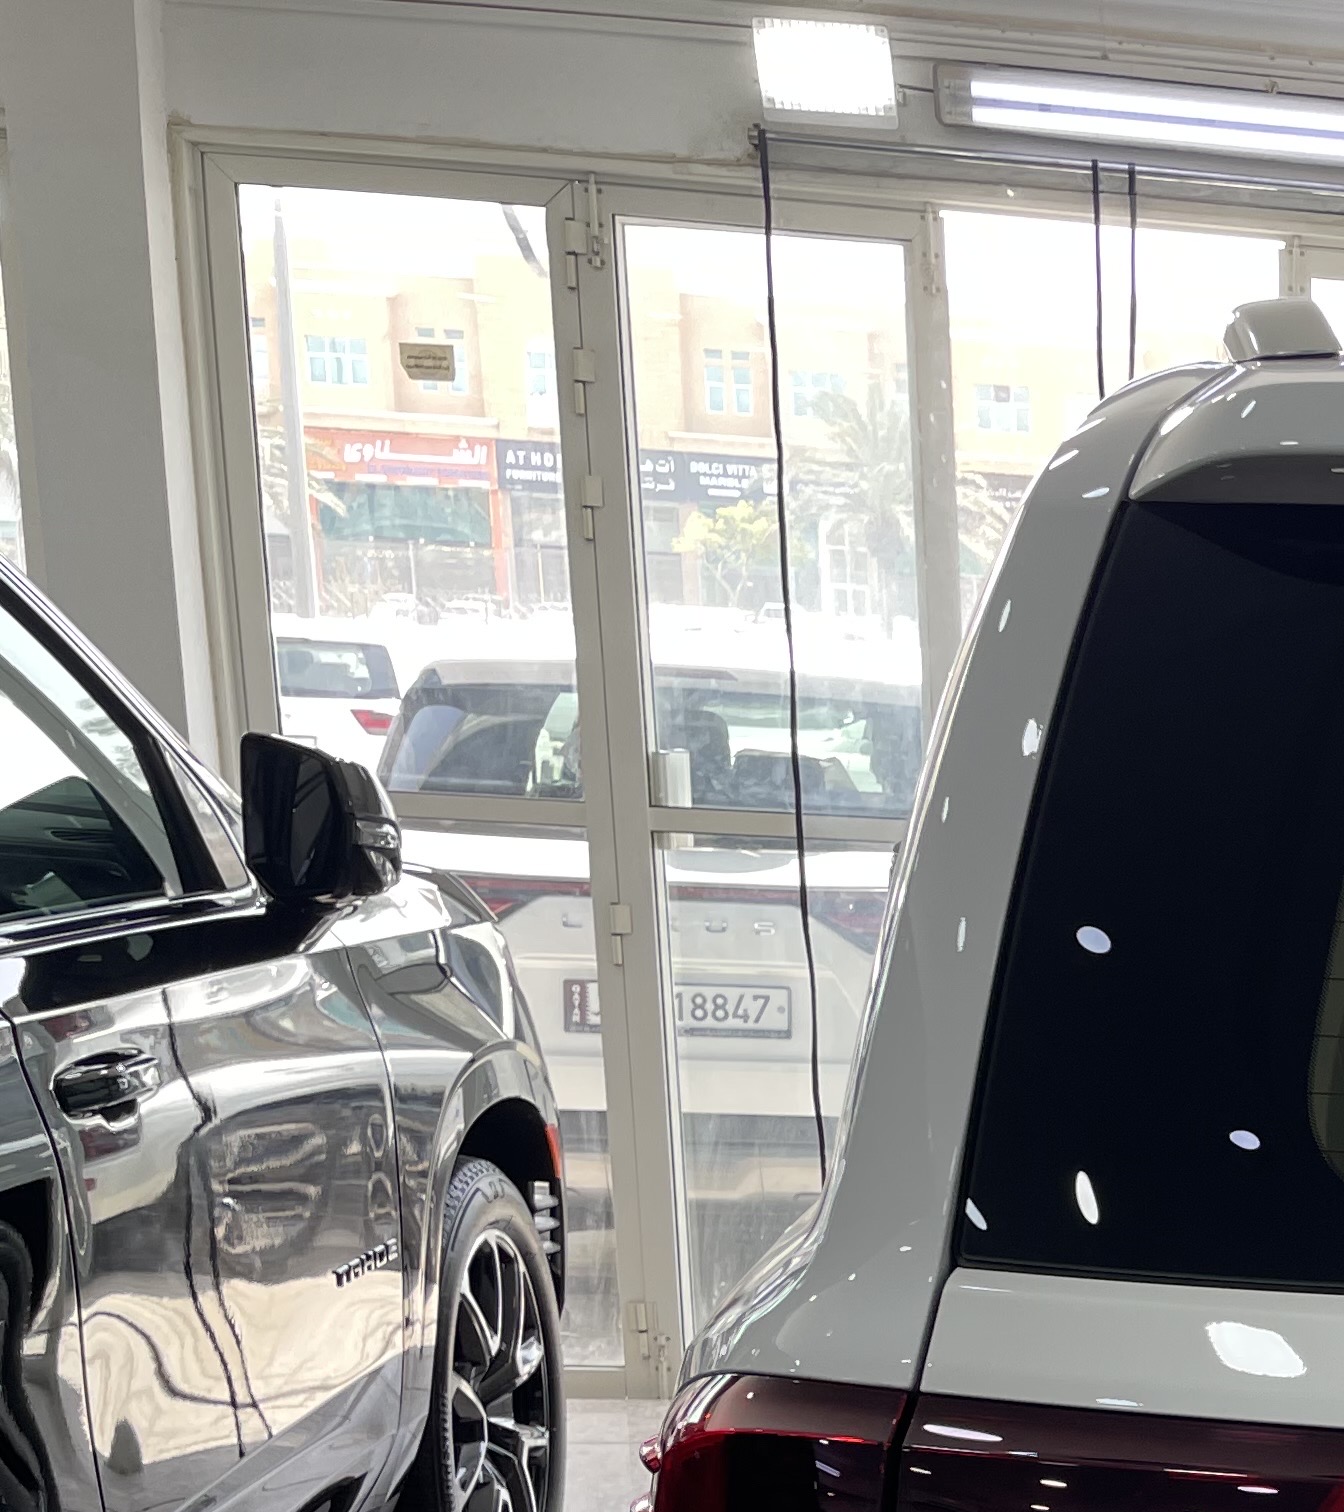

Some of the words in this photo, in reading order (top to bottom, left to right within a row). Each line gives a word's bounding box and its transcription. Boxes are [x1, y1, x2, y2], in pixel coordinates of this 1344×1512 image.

[505, 449, 526, 466] AT
[689, 461, 723, 475] DOLCI
[725, 463, 758, 479] VITTA
[699, 475, 750, 489] MARBLE
[561, 911, 777, 937] LUS
[331, 1237, 399, 1288] TAHOE
